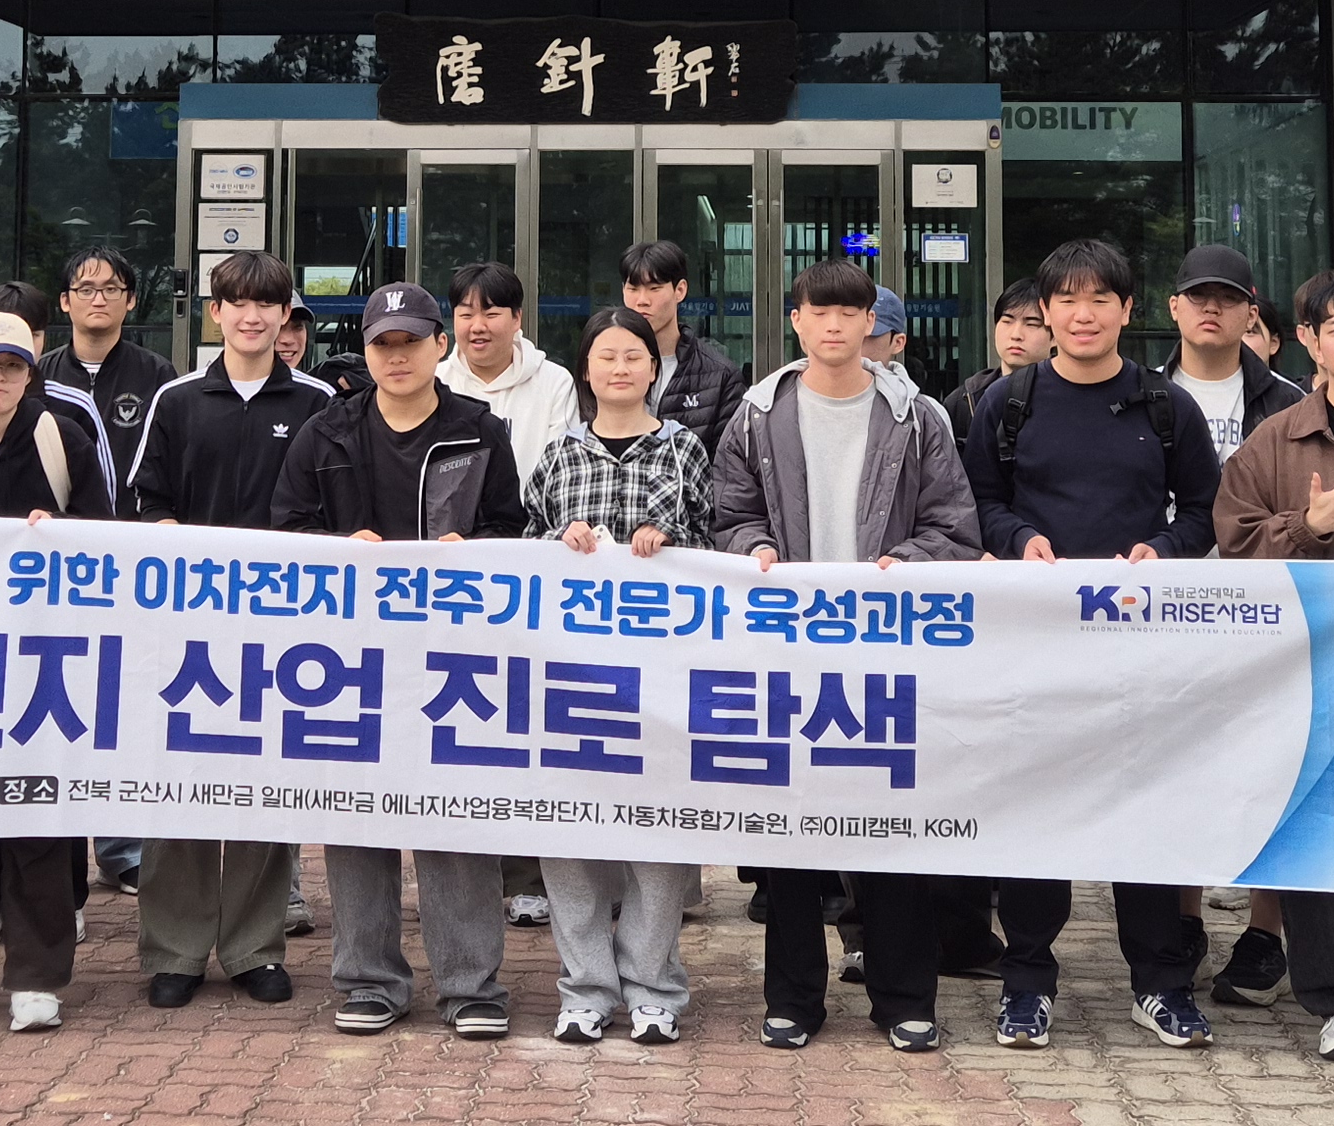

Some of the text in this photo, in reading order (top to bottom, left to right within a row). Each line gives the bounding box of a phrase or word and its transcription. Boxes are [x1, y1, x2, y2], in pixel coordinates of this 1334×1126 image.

[7, 550, 120, 607] 위한
[134, 556, 357, 620] 이차전지
[374, 566, 542, 630] 전주기
[559, 578, 731, 640] 전문가
[745, 587, 975, 647] 육성과정
[1161, 602, 1282, 625] RISE사업단
[1162, 586, 1246, 600] 국립군산대학교
[158, 640, 385, 764] 산업
[420, 650, 644, 775] 진로
[687, 668, 917, 790] 탐색
[68, 779, 111, 802] 전북
[118, 780, 183, 804] 군산시
[189, 783, 254, 807] 새만금
[261, 785, 375, 814] 일대(새만금
[382, 793, 605, 825] 에너지산업융복합단지,
[612, 804, 793, 836] 자동차융합기술원,
[924, 817, 978, 841] KGM)
